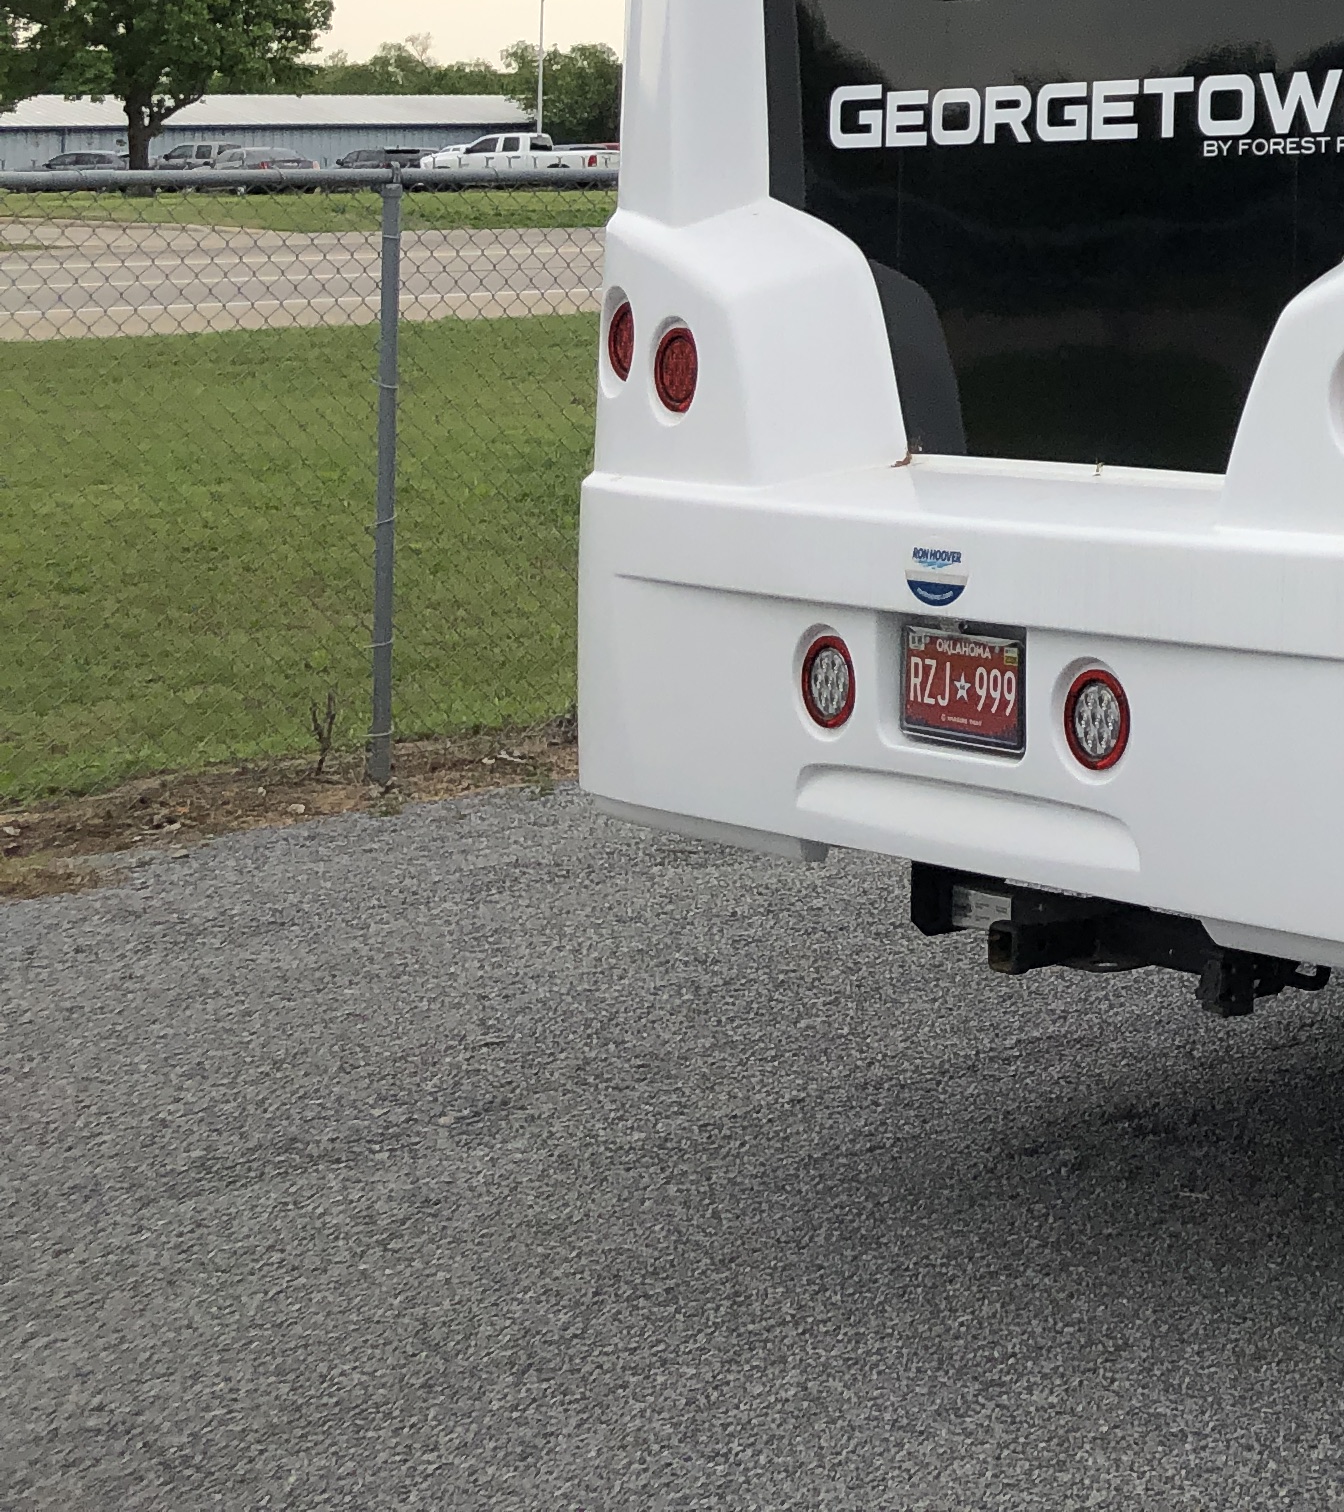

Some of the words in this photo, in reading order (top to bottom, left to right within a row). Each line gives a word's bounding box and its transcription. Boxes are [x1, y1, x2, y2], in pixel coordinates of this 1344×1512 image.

[1203, 140, 1233, 157] BY
[1238, 136, 1331, 156] FOREST
[912, 546, 929, 560] RON
[929, 548, 962, 564] HOOVER
[936, 638, 992, 660] OKLAHOMA
[909, 656, 951, 707] RZJ
[974, 666, 1016, 717] 999
